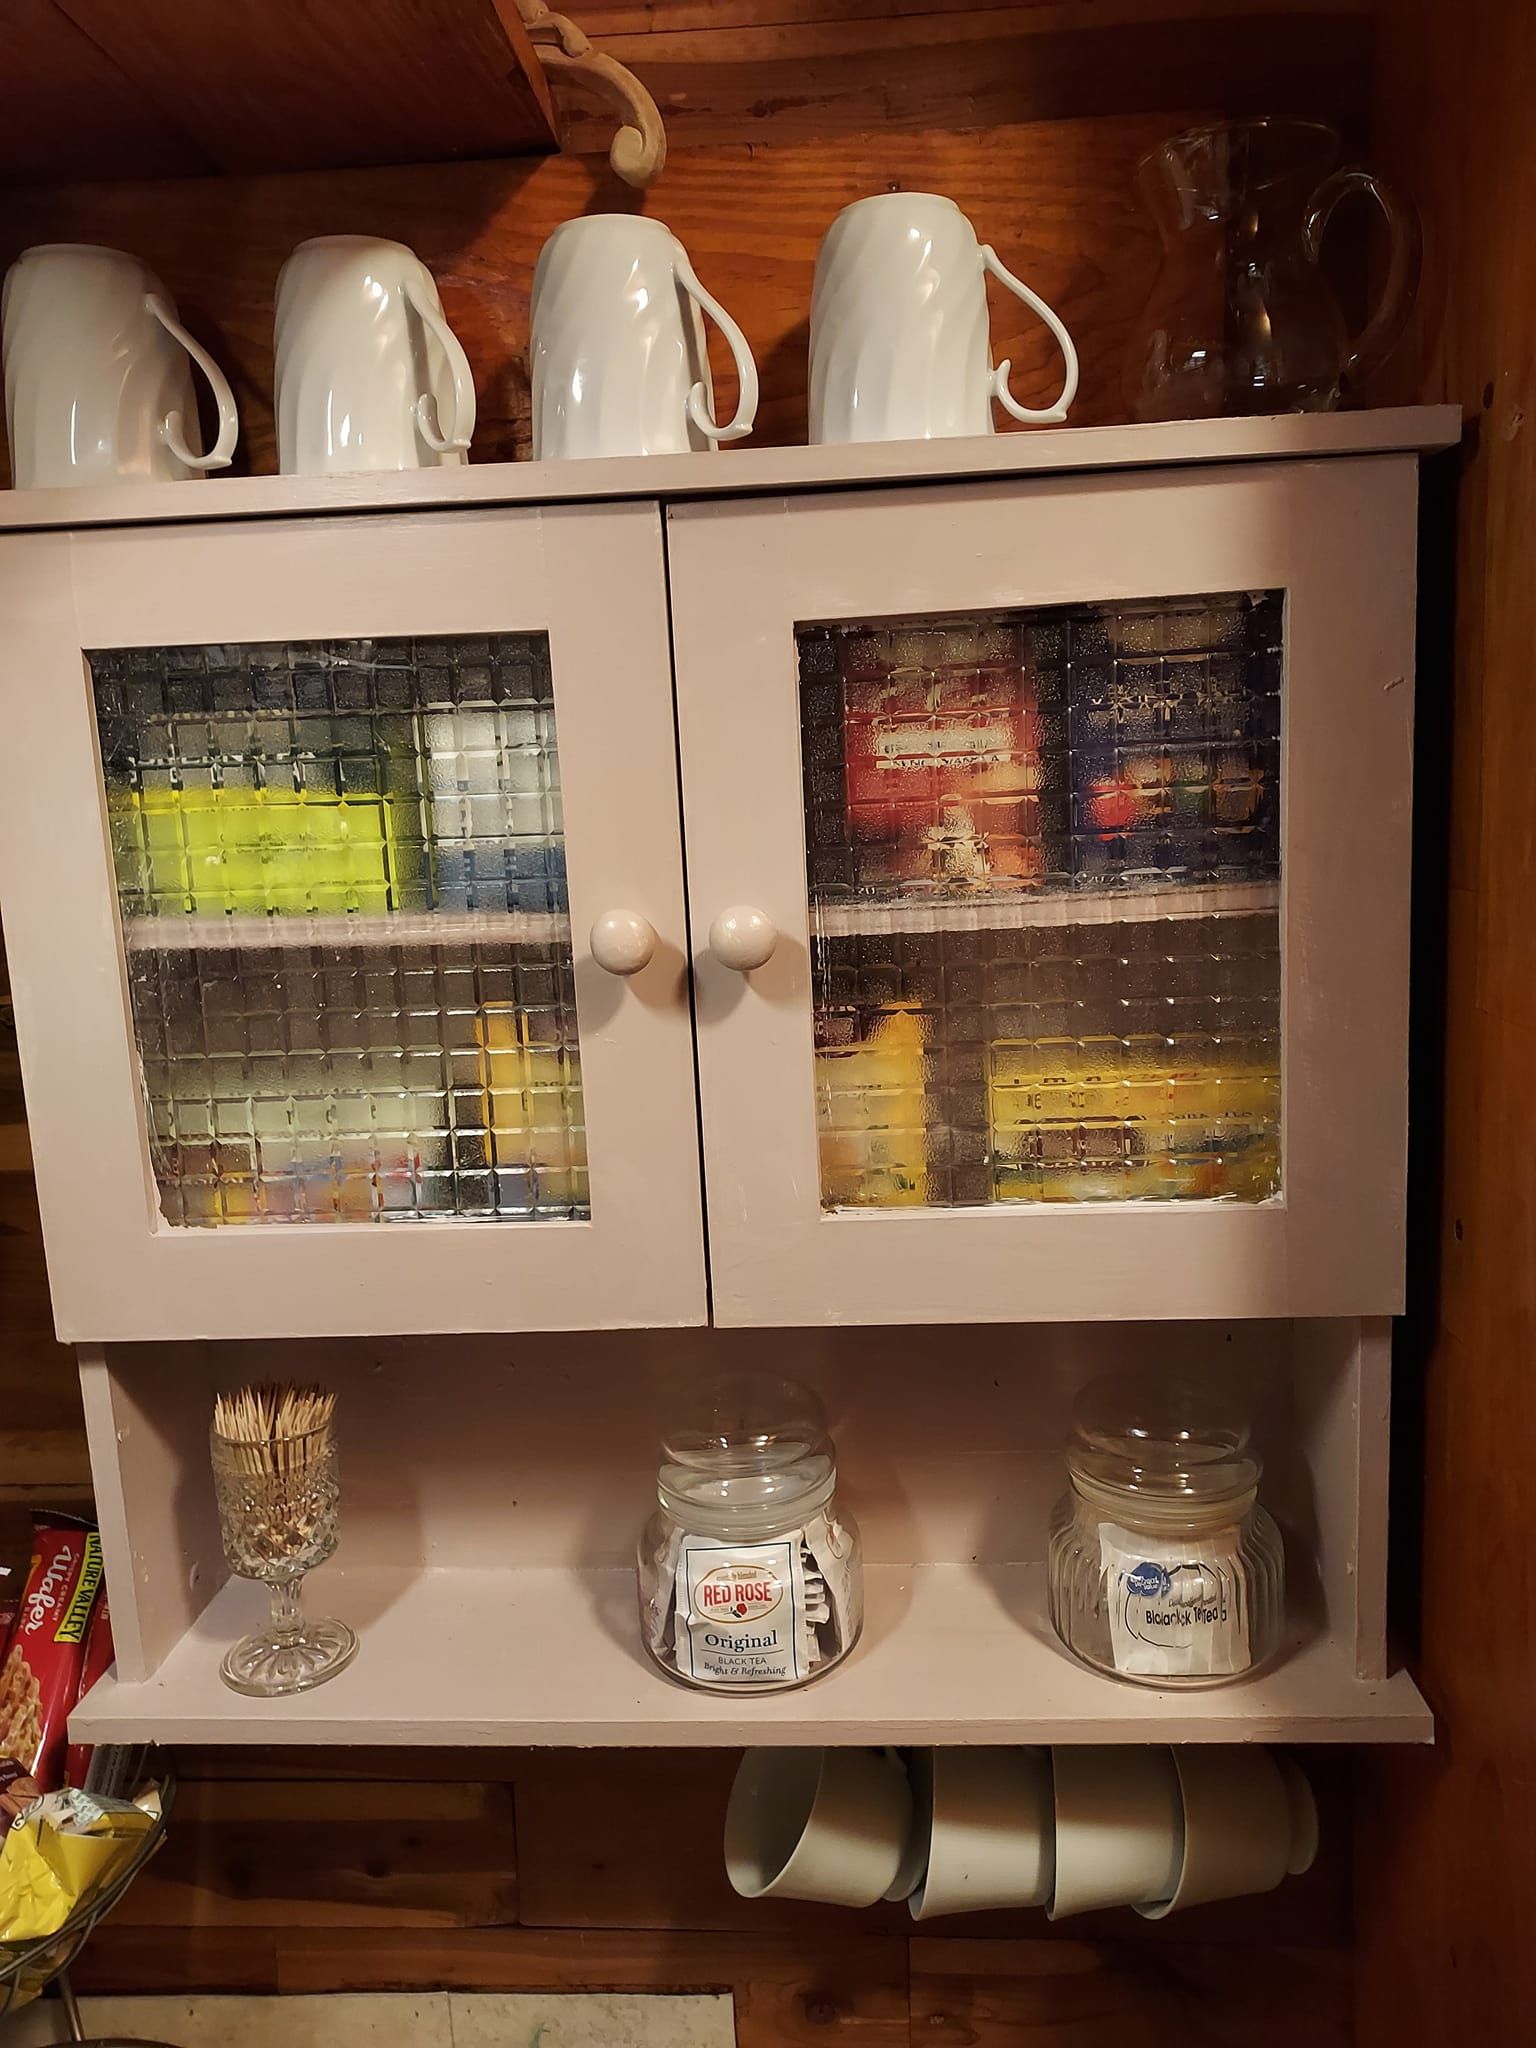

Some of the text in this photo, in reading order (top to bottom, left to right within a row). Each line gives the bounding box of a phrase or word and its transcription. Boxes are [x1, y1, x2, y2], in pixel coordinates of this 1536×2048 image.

[25, 1545, 72, 1636] Wafer
[704, 1582, 773, 1607] RED ROSE
[58, 1589, 95, 1641] VALLEY
[704, 1629, 778, 1653] Original
[703, 1662, 787, 1677] Bright & Refreshing
[718, 1656, 767, 1665] BLACK TEA
